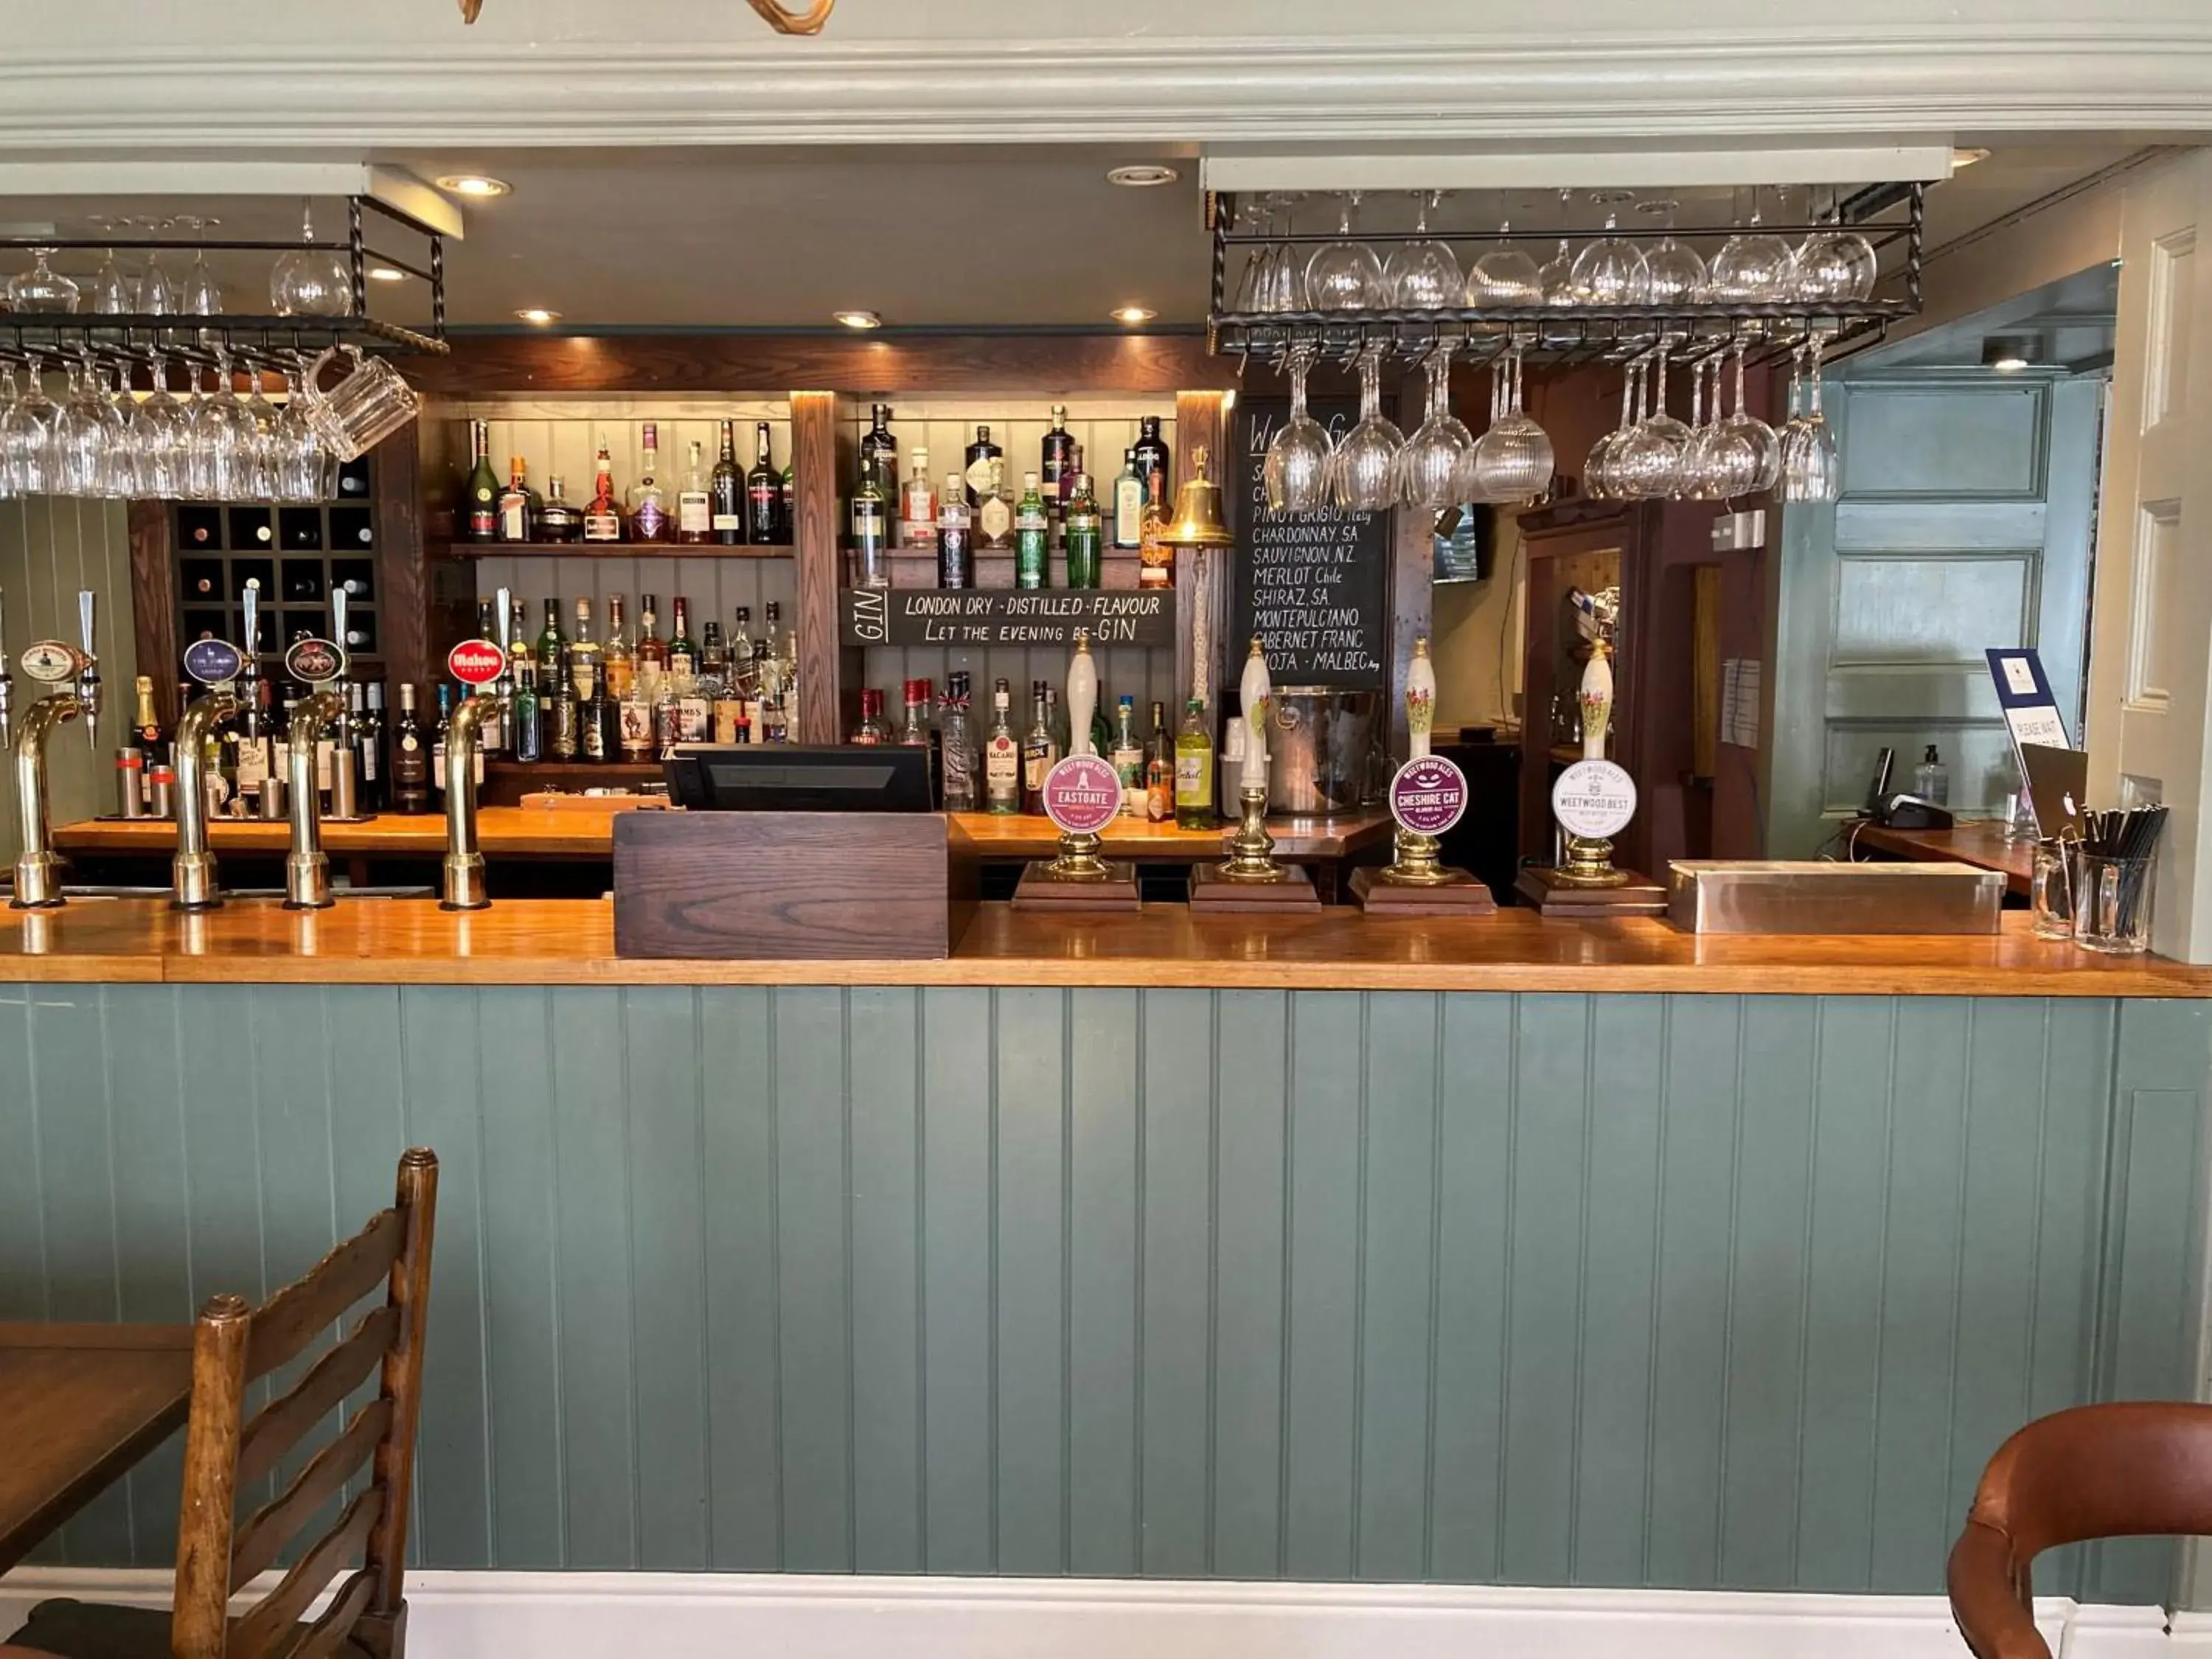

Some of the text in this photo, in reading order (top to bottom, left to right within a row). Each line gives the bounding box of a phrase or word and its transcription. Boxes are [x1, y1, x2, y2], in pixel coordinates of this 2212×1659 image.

[905, 596, 1161, 615] LONDON DRY DISTILLED FLAVOUR
[853, 590, 884, 640] GIN
[1253, 608, 1360, 627] MONTEPULCIANO
[963, 626, 990, 641] THE
[999, 626, 1064, 641] EVENING
[1321, 629, 1363, 649] FRANC
[453, 653, 498, 667] Mahou
[1264, 652, 1298, 670] IOJA
[1312, 651, 1368, 670] MALBEC
[1057, 791, 1108, 804] EASTGATE
[1397, 791, 1460, 807] CHESHIRE CAT
[1559, 797, 1629, 810] WEETWOOD BEST
